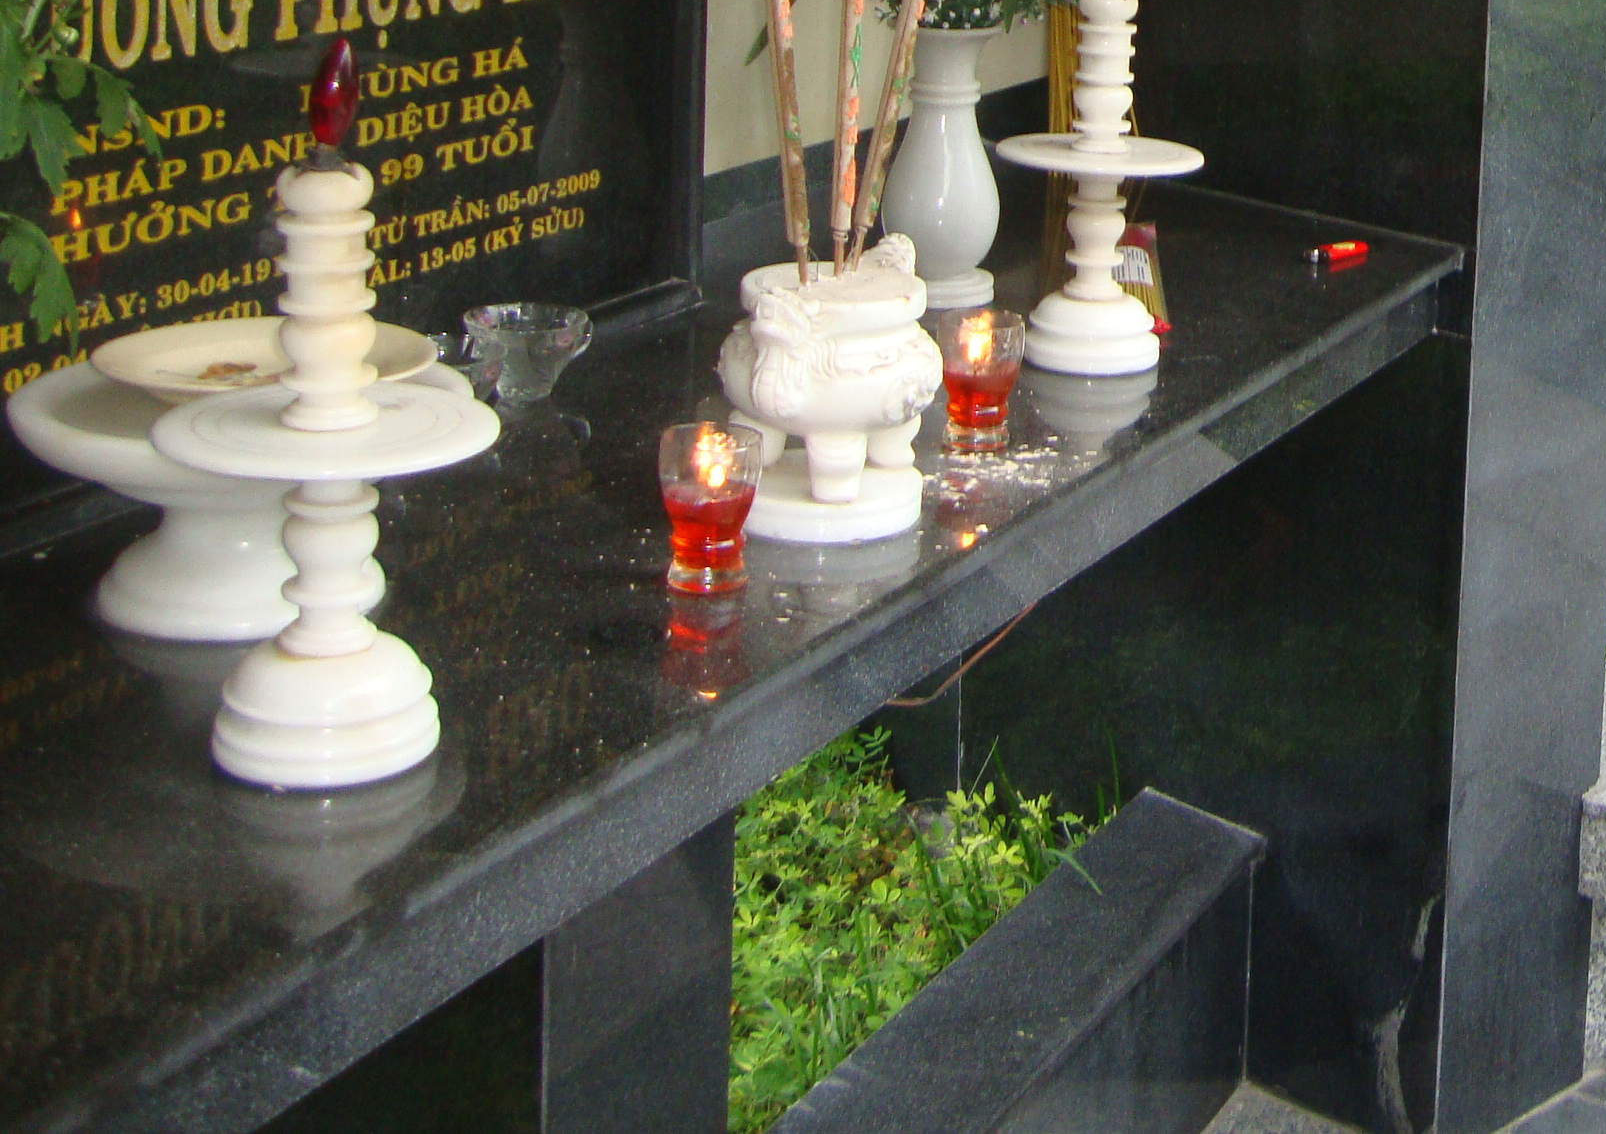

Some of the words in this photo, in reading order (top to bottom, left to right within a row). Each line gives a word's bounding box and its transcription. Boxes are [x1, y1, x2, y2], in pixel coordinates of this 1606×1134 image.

[472, 36, 529, 79] HÁ
[50, 200, 253, 264] HƯỞNG
[380, 153, 424, 187] 99
[436, 117, 535, 172] TUỔI
[51, 158, 188, 216] PHÁP
[356, 102, 451, 148] DIỆU
[461, 85, 534, 124] HÒA
[367, 215, 407, 250] TỪ
[413, 194, 491, 238] TRẦN:
[496, 168, 601, 215] 05-07-2009
[368, 256, 412, 288] ÂL:
[419, 236, 477, 273] 13-05
[484, 216, 525, 254] (KỶ
[531, 205, 585, 240] SỬU)
